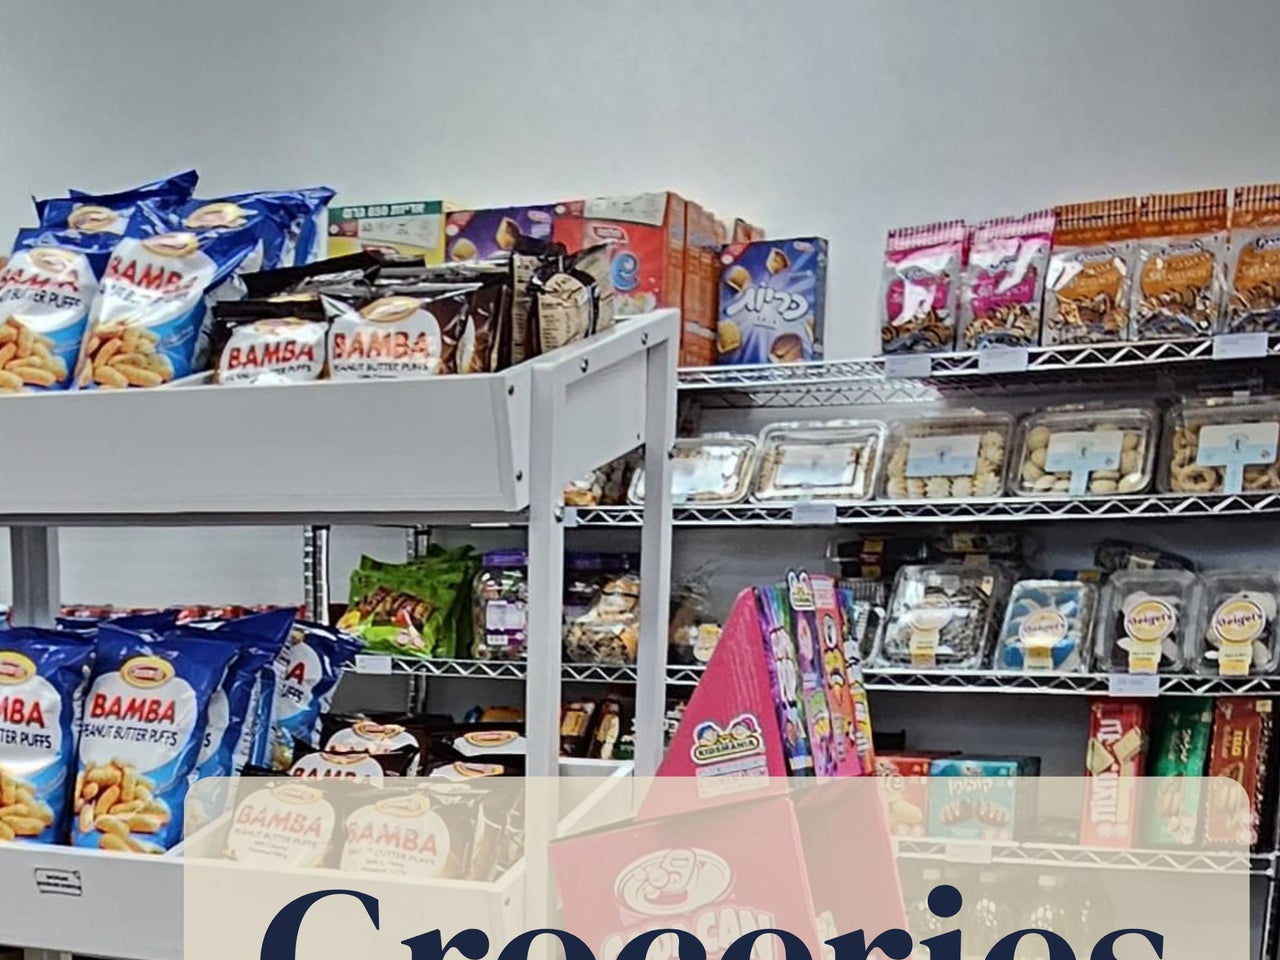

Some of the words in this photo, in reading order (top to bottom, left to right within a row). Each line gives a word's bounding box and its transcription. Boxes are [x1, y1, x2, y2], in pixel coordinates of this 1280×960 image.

[227, 340, 315, 370] BAMBA
[333, 331, 431, 360] BAMBA
[90, 693, 176, 725] BAMBA
[20, 732, 52, 750] PUFFS
[116, 725, 149, 742] BUTTER
[150, 728, 178, 747] PUFFS
[697, 738, 759, 761] KIDSMANIA
[236, 804, 322, 838] BAMBA
[264, 831, 291, 843] BUTTER
[293, 836, 318, 849] PUFFS
[347, 820, 438, 857] BAMBA
